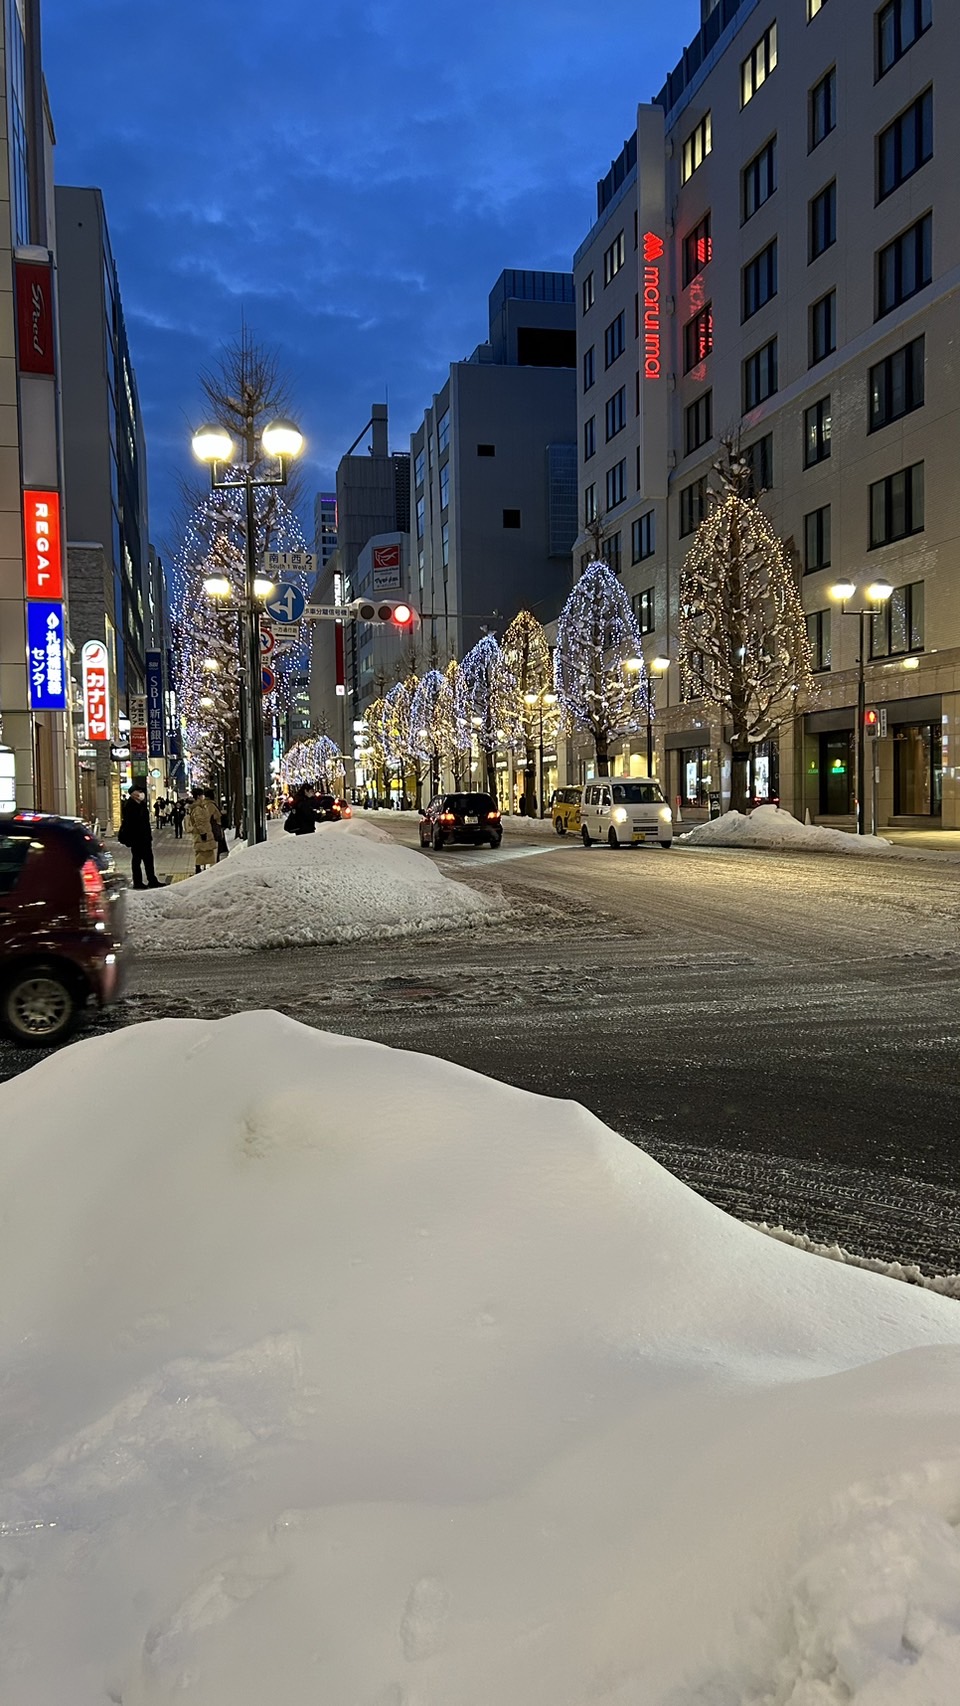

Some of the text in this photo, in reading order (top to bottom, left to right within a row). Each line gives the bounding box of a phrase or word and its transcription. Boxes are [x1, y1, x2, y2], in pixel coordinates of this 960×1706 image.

[644, 266, 661, 379] marui imai
[34, 502, 49, 587] REGAL
[31, 647, 46, 699] センター
[87, 672, 106, 735] カナリヤ
